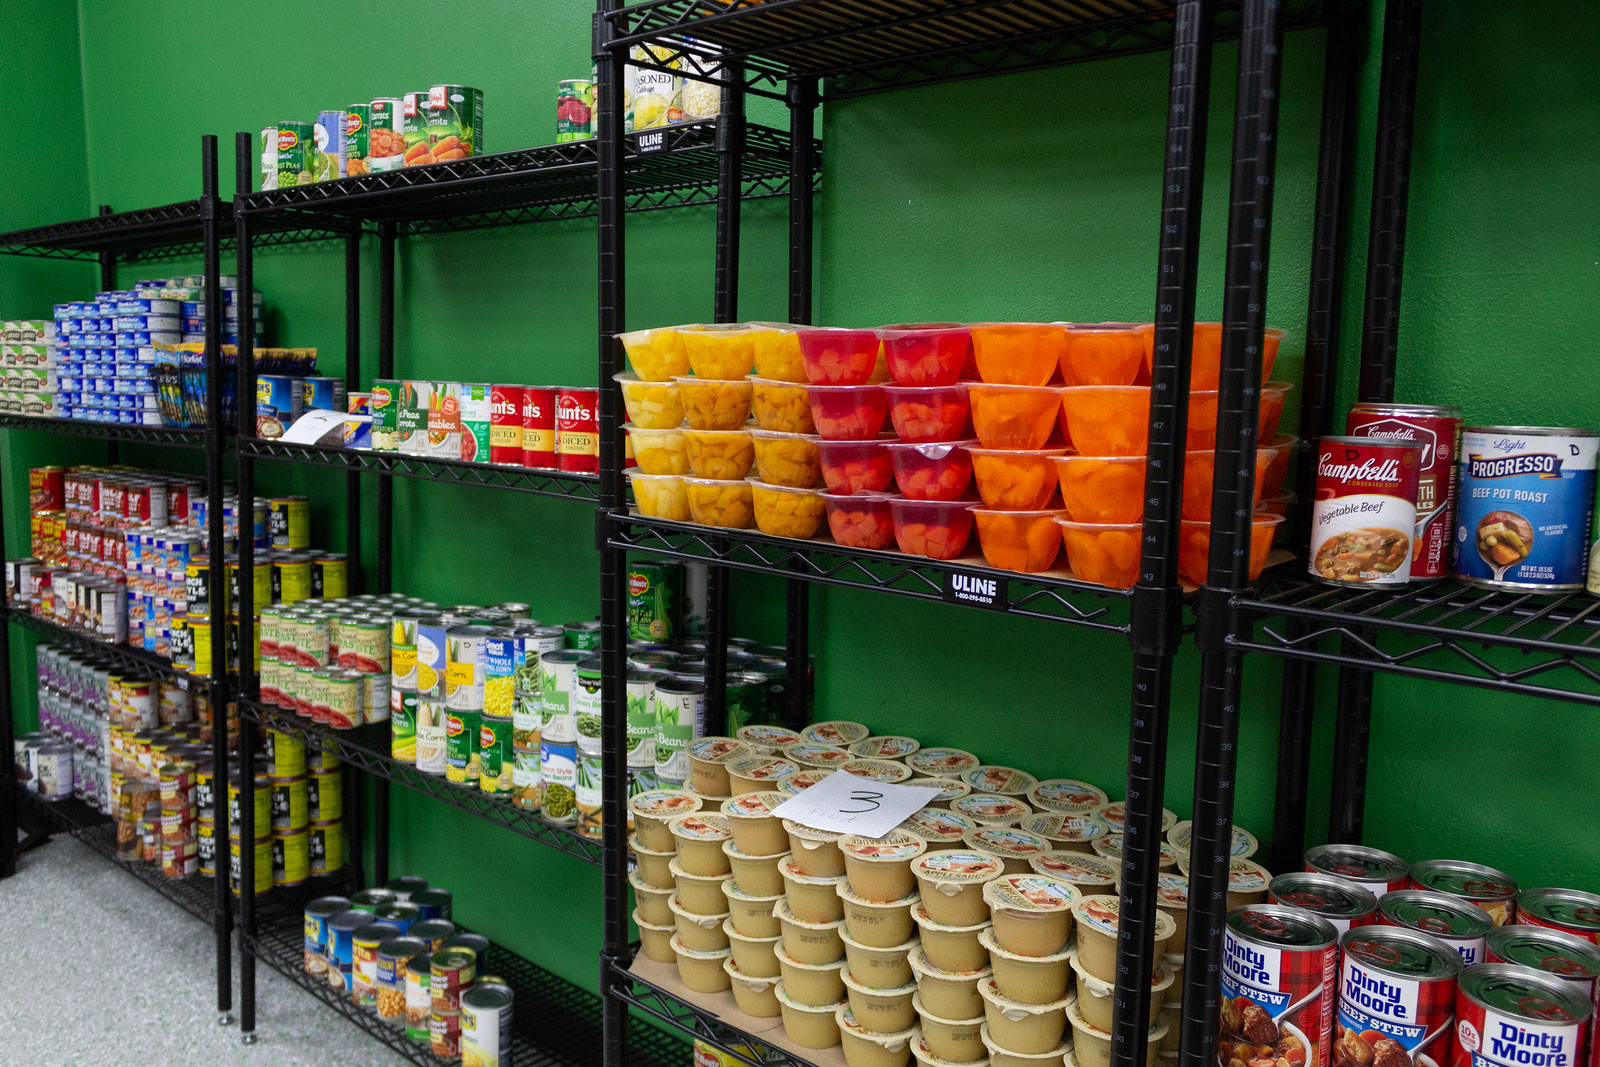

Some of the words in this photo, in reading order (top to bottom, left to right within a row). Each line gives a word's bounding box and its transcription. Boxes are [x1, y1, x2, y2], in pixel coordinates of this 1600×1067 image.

[639, 133, 663, 147] ULINE
[1367, 425, 1416, 441] Campbell's
[562, 437, 591, 446] DICED
[1493, 438, 1526, 454] Light
[1344, 449, 1360, 462] D
[1569, 444, 1580, 456] D
[1318, 452, 1400, 484] Campbell's
[1472, 456, 1554, 477] PROGRESSO
[1347, 479, 1383, 488] CONDENSED
[1384, 481, 1399, 489] SOUP
[1418, 486, 1434, 500] TH
[1472, 487, 1492, 498] BEEF
[1493, 488, 1512, 499] POT
[1514, 489, 1549, 503] ROAST
[1318, 503, 1361, 526] Vegetable
[1360, 500, 1385, 514] Beef
[952, 574, 997, 596] ULINE
[490, 656, 512, 666] WHOLE
[495, 665, 512, 673] CORN
[839, 790, 884, 813] 3
[1036, 796, 1091, 811] APPLESAUCE
[853, 836, 911, 845] APPLESAUCE
[923, 869, 986, 879] APPLESAUCE
[1225, 933, 1265, 971] Dinty
[1223, 949, 1270, 986] Moore
[1350, 964, 1402, 1004] Dinty
[1239, 985, 1285, 1006] STEW
[1345, 978, 1406, 1018] Moore
[1338, 997, 1369, 1025] BEEF
[1369, 1018, 1421, 1038] STEW
[1498, 1021, 1564, 1053] Dinty
[1490, 1037, 1567, 1067] Moore
